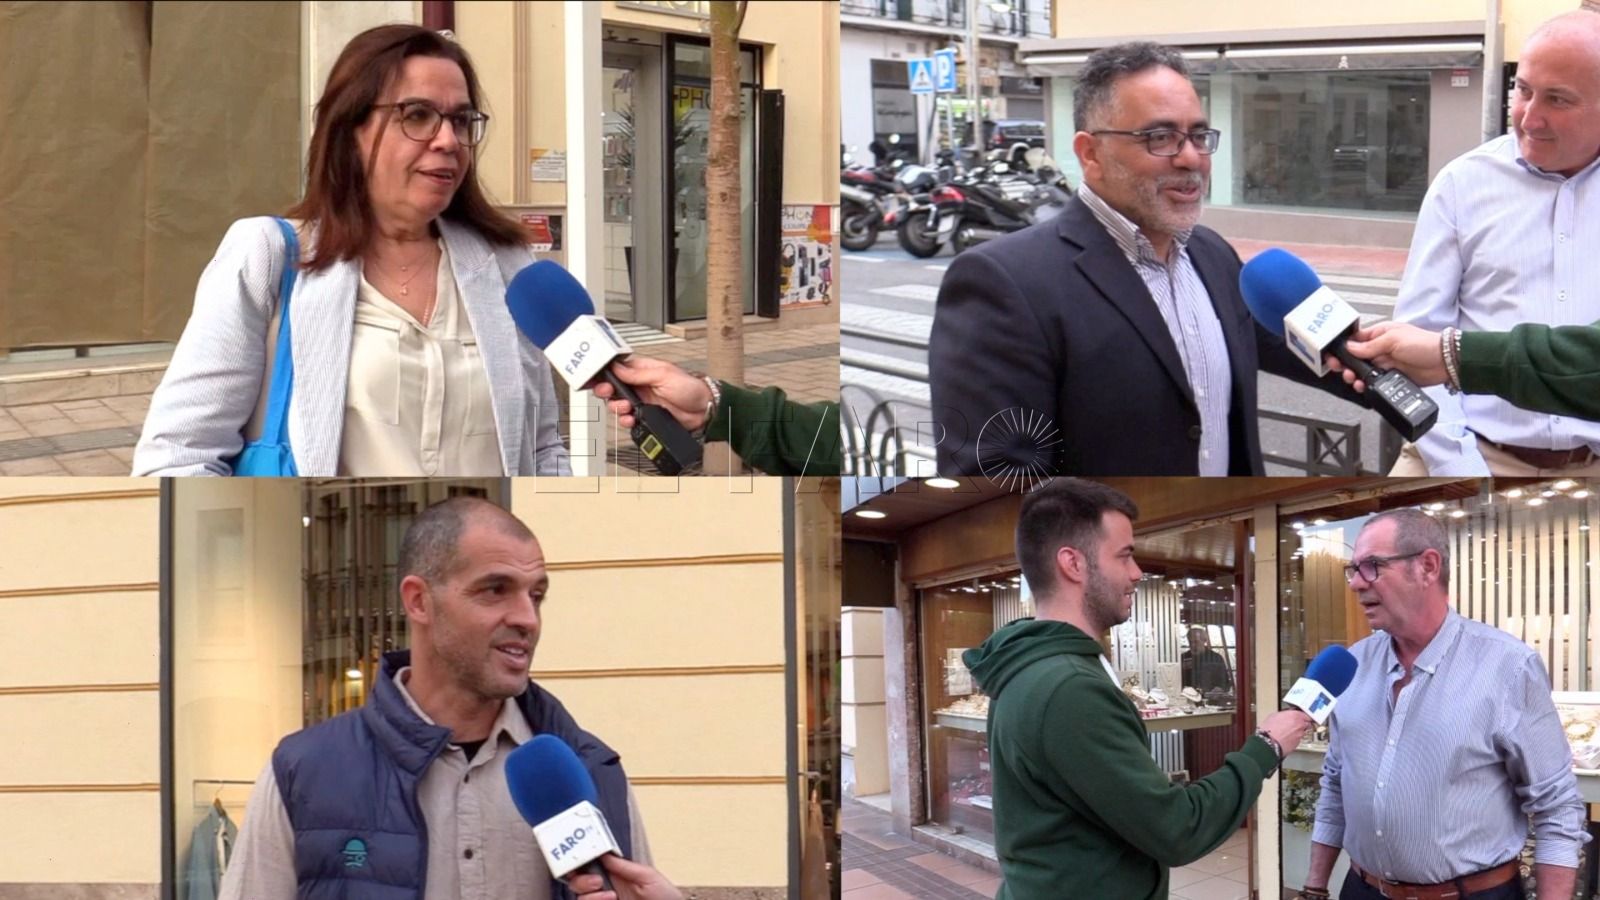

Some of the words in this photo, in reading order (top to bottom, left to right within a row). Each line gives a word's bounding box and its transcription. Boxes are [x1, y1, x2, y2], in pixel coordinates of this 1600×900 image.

[937, 55, 951, 87] P
[1307, 303, 1334, 334] FARO
[565, 341, 590, 375] FARO
[550, 828, 586, 861] FARO
